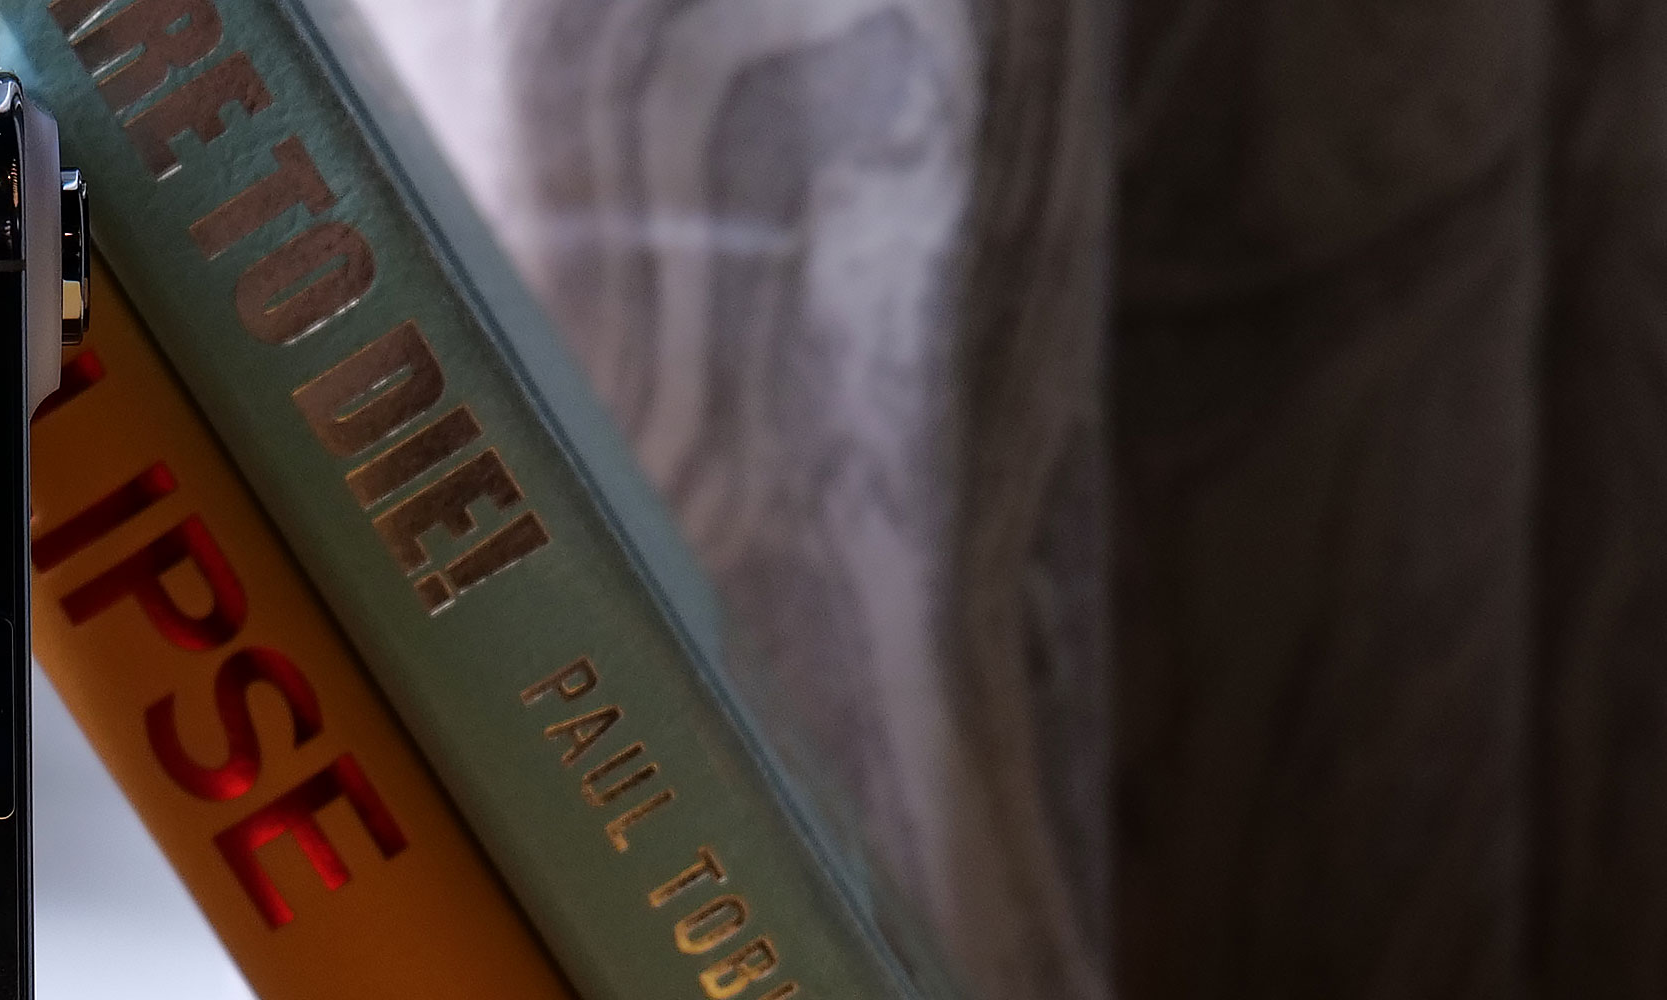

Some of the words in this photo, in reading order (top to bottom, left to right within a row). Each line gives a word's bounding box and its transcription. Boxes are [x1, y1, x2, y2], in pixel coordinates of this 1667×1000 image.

[45, 0, 273, 182] RE
[188, 134, 377, 346] TO
[291, 318, 551, 617] DIE!
[520, 655, 675, 853] PAUL
